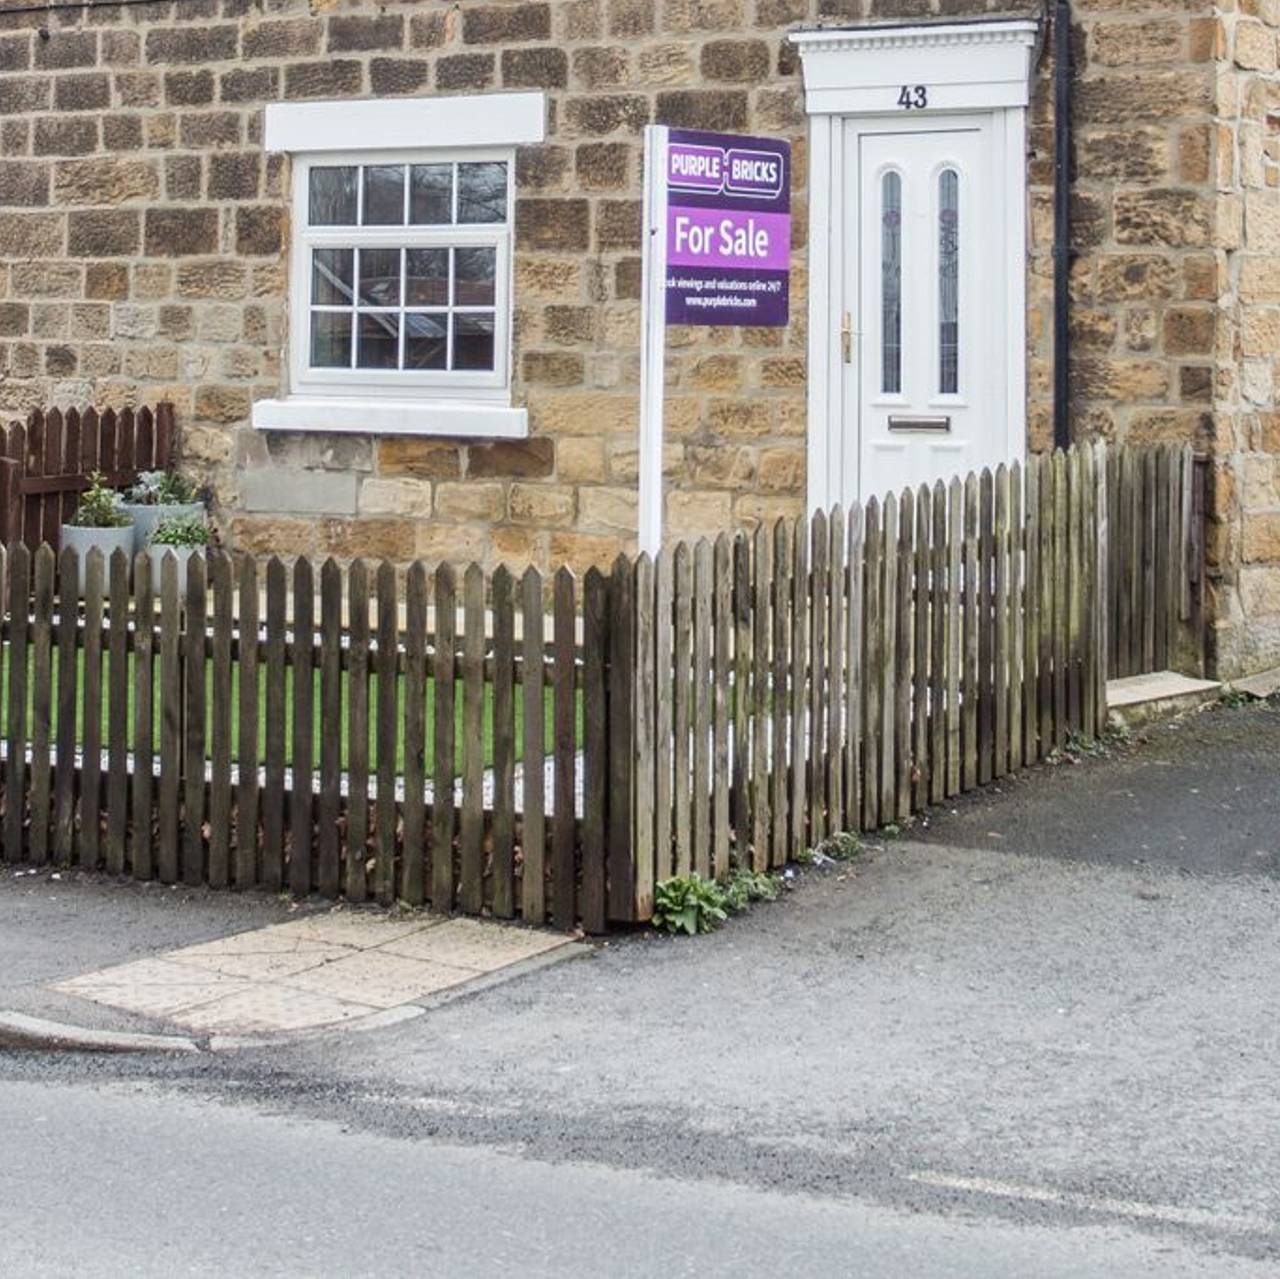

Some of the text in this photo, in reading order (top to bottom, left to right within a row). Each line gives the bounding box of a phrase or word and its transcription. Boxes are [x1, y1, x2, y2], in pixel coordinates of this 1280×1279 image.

[897, 85, 927, 109] 43
[671, 154, 777, 182] PURPLE BRICKS
[675, 217, 768, 256] For Sale
